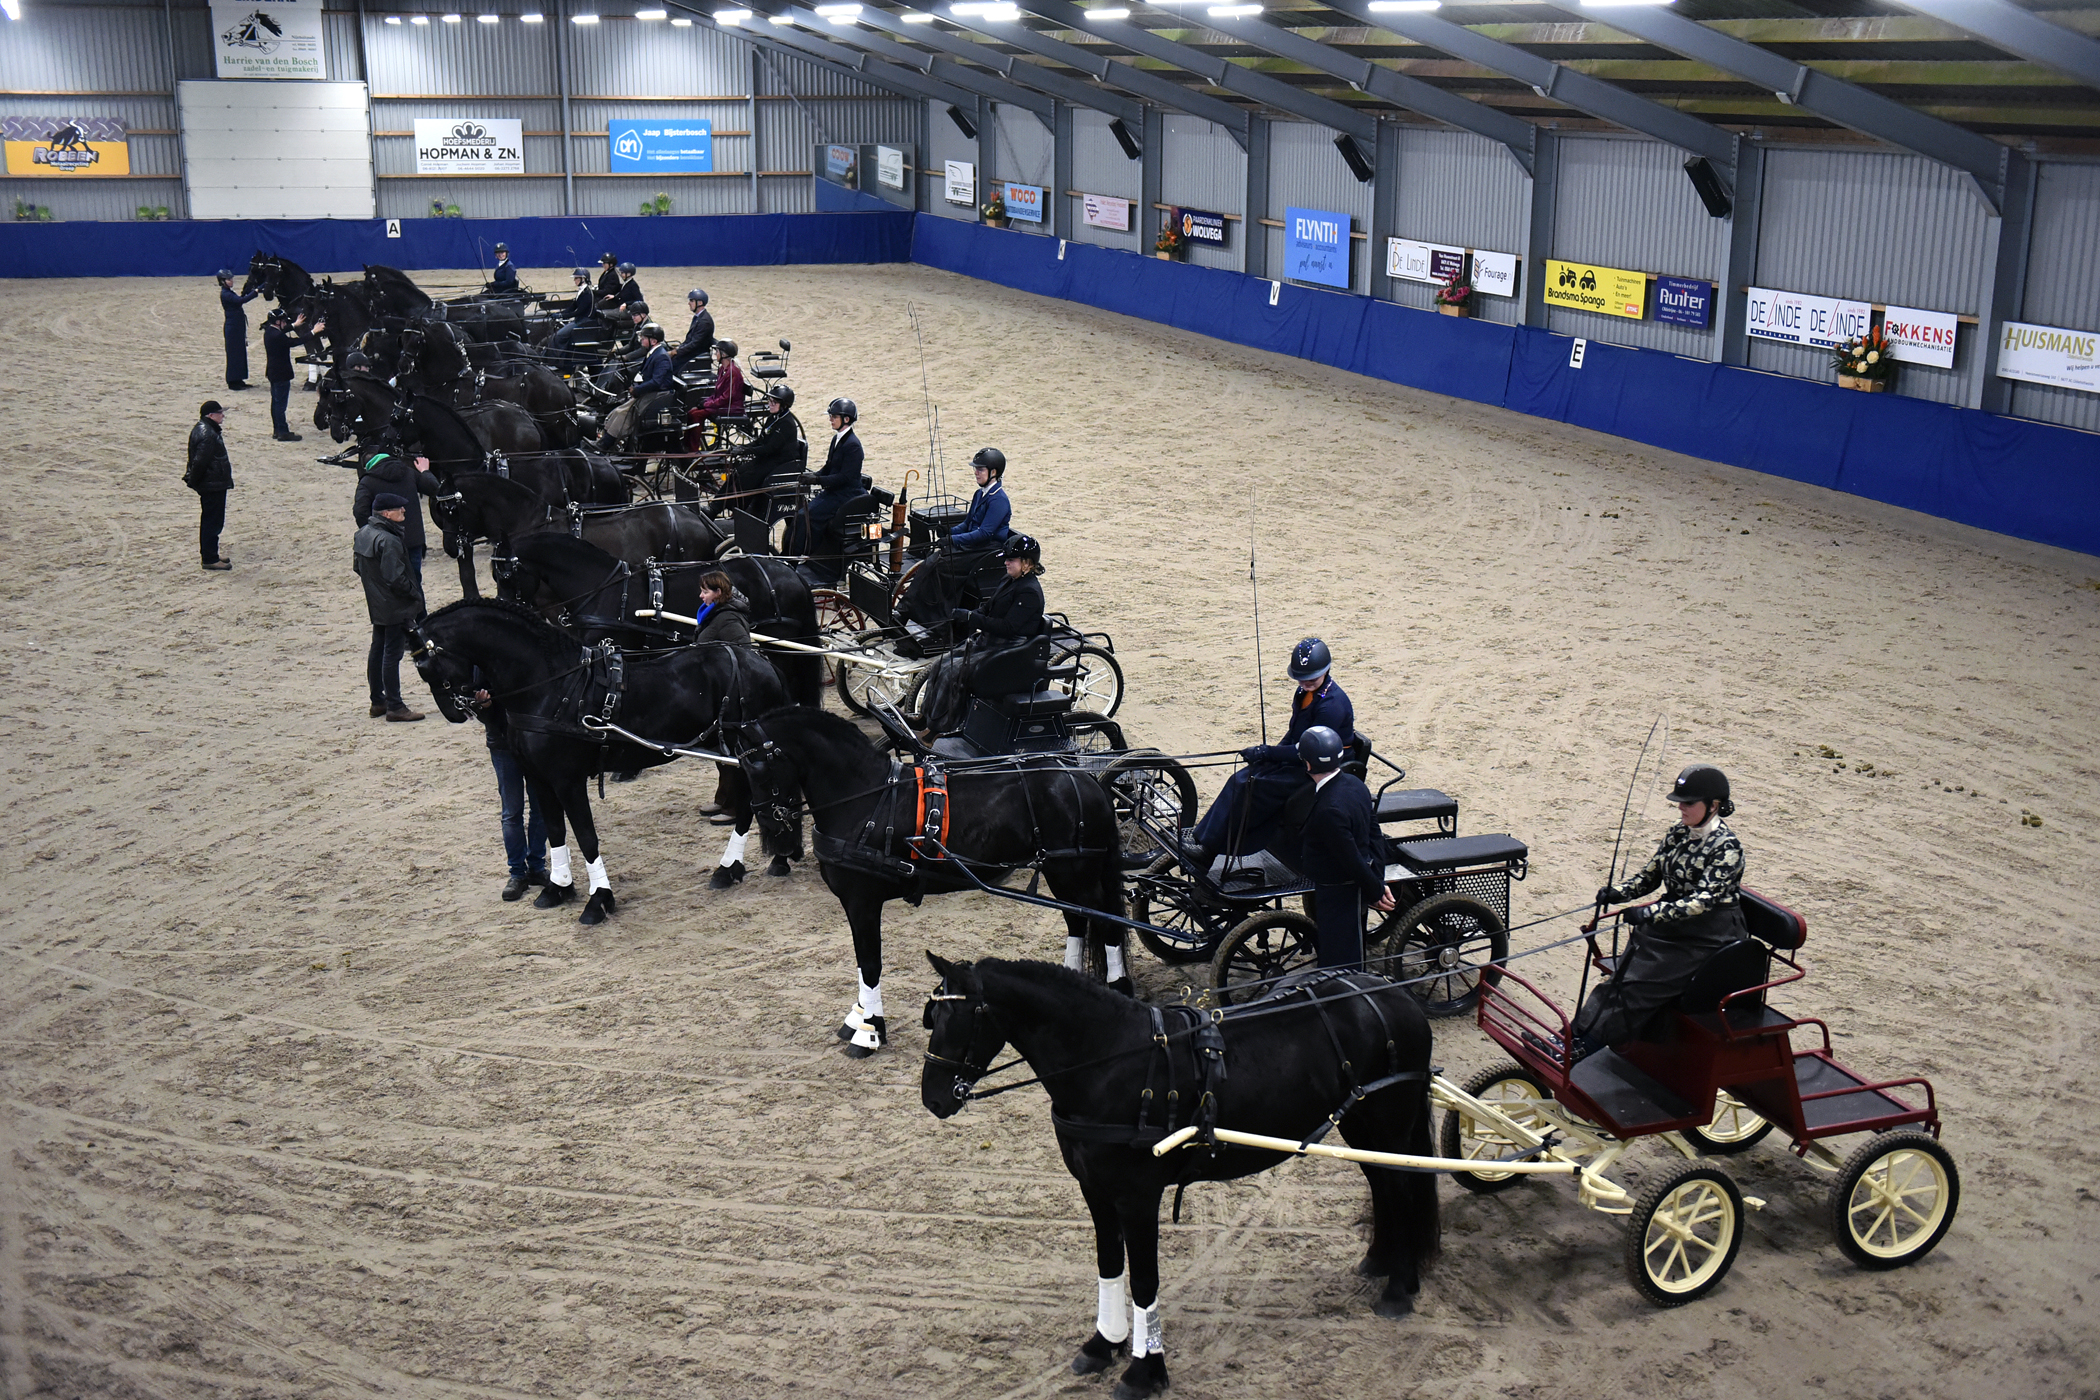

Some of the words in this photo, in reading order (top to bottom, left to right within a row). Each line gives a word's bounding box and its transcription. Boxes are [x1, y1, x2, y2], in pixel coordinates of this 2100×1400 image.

[223, 56, 253, 65] Harrie
[273, 57, 289, 65] den
[292, 57, 319, 66] Bosch
[277, 65, 319, 73] tuigmakerij
[642, 128, 661, 137] Jaap
[663, 128, 708, 137] Bijsterbosch
[443, 138, 496, 146] HOEFSMEDERIJ
[419, 148, 480, 160] HOPMAN
[484, 148, 493, 160] &
[498, 148, 520, 160] ZN.
[1010, 187, 1036, 205] WOCO
[389, 222, 399, 235] A
[1192, 215, 1223, 228] PAARDENKLINIEK
[1192, 224, 1223, 242] WOLVEGA
[1295, 217, 1339, 245] FLYNTH
[1272, 285, 1279, 301] V
[1668, 280, 1700, 291] Timmerbedrijf
[1548, 287, 1580, 303] Brandsma
[1580, 292, 1606, 309] Spanga
[1660, 287, 1706, 310] Ruiter
[1750, 300, 1767, 324] DE
[1767, 293, 1802, 330] LINDE
[1810, 309, 1827, 333] DE
[1827, 301, 1866, 339] LINDE
[1751, 328, 1799, 341] MAKELAARS
[2003, 327, 2096, 357] HUISMANS
[1572, 343, 1584, 363] E
